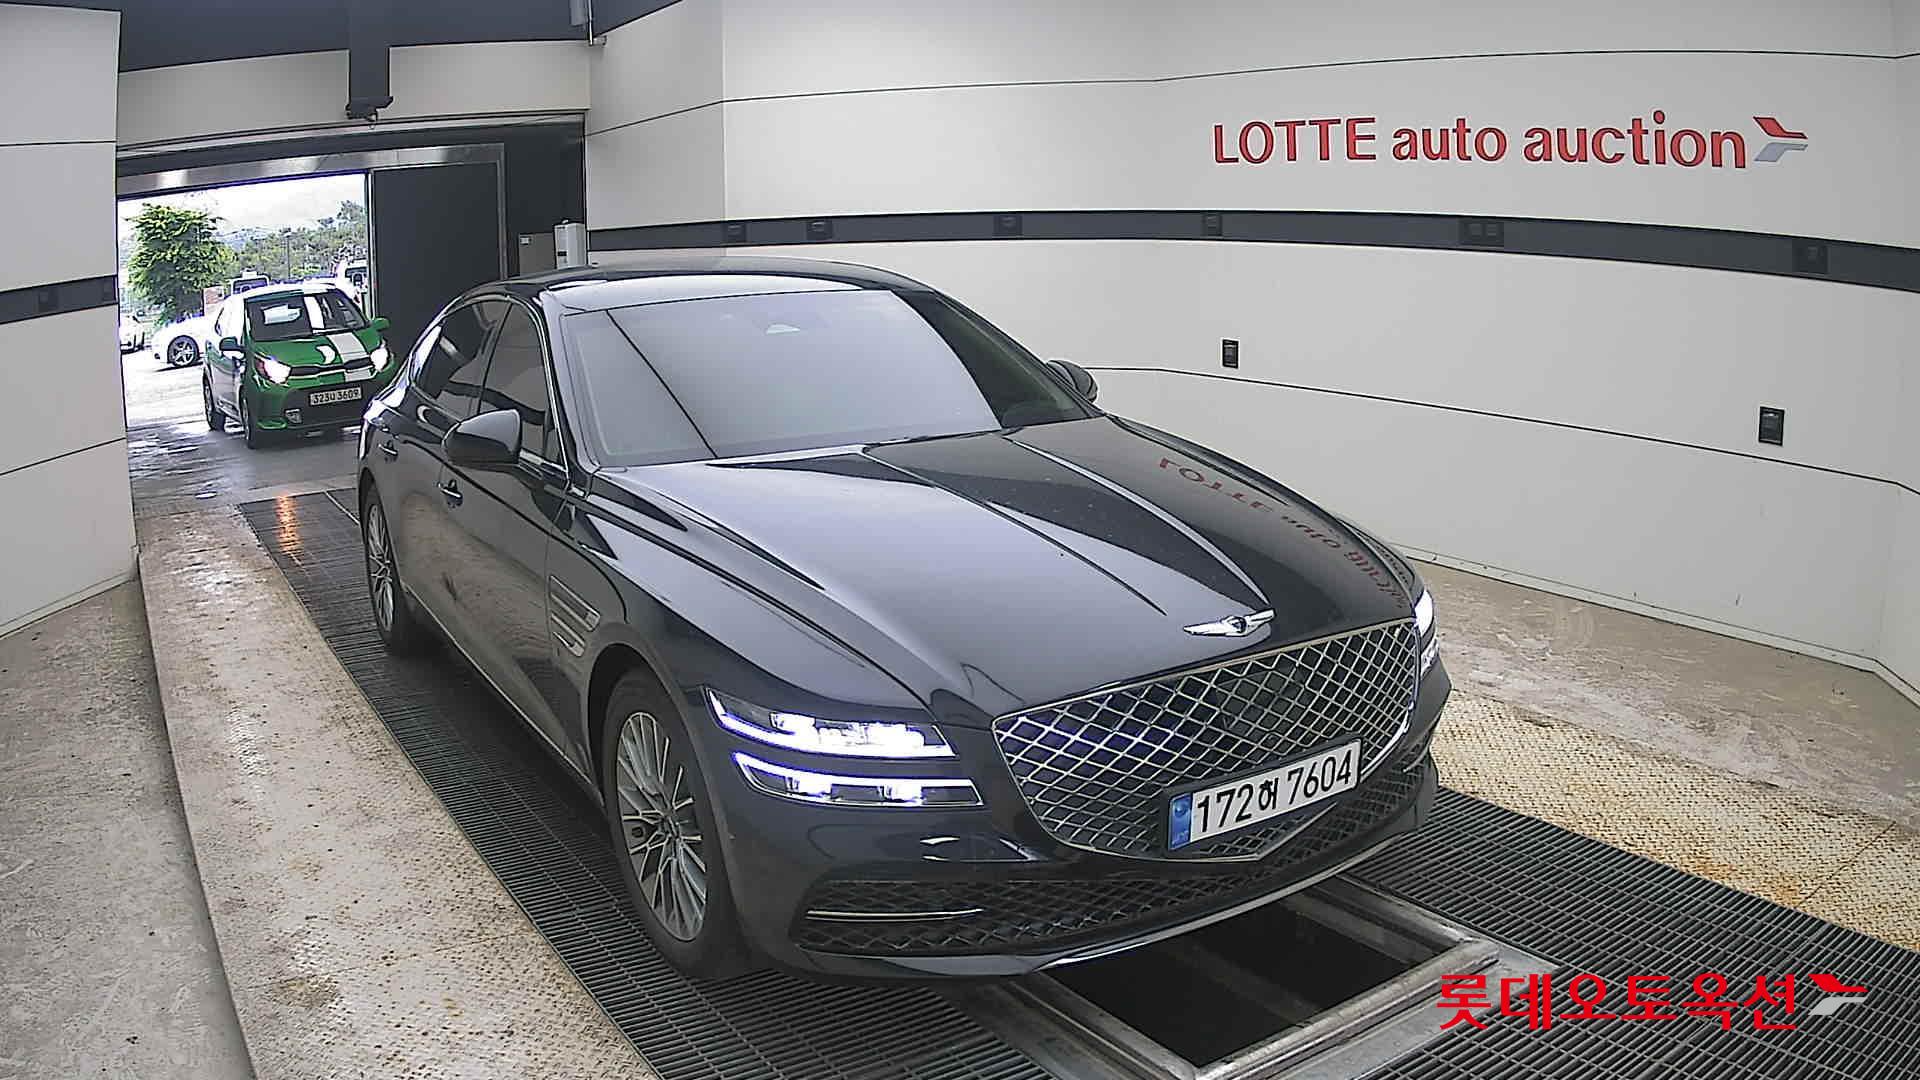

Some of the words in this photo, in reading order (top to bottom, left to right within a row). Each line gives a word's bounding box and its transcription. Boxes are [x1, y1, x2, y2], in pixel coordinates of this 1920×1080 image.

[1214, 118, 1376, 163] LOTTE
[1393, 118, 1508, 161] auto
[1522, 111, 1746, 168] auction
[1197, 777, 1280, 833] 172허
[1286, 748, 1352, 805] 7604
